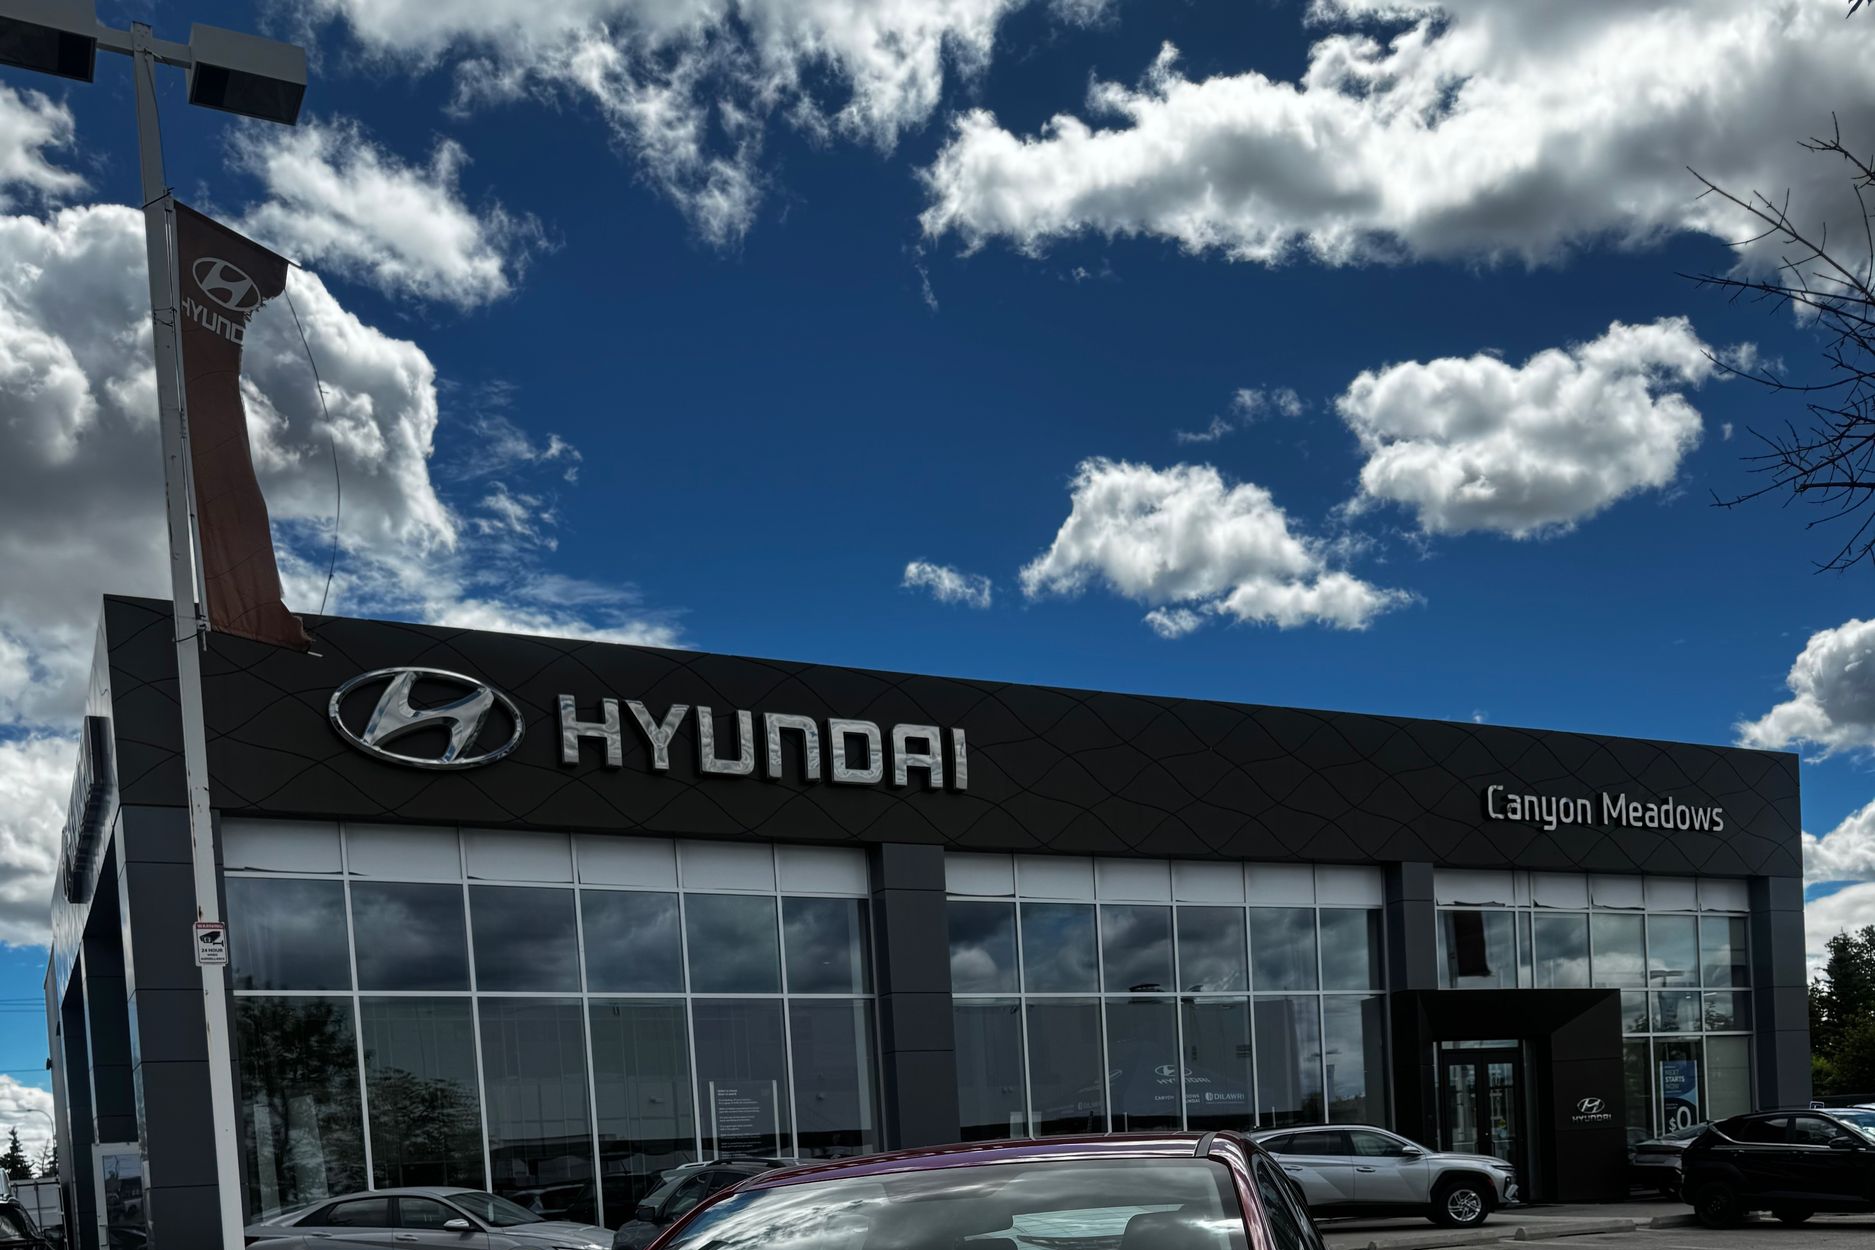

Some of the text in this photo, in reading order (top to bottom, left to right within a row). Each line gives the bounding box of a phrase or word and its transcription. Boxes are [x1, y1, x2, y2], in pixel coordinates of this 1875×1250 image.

[557, 693, 968, 789] HYUNDAI
[1487, 784, 1724, 832] Canyon Meadows
[1571, 1113, 1612, 1122] HYUNDAI
